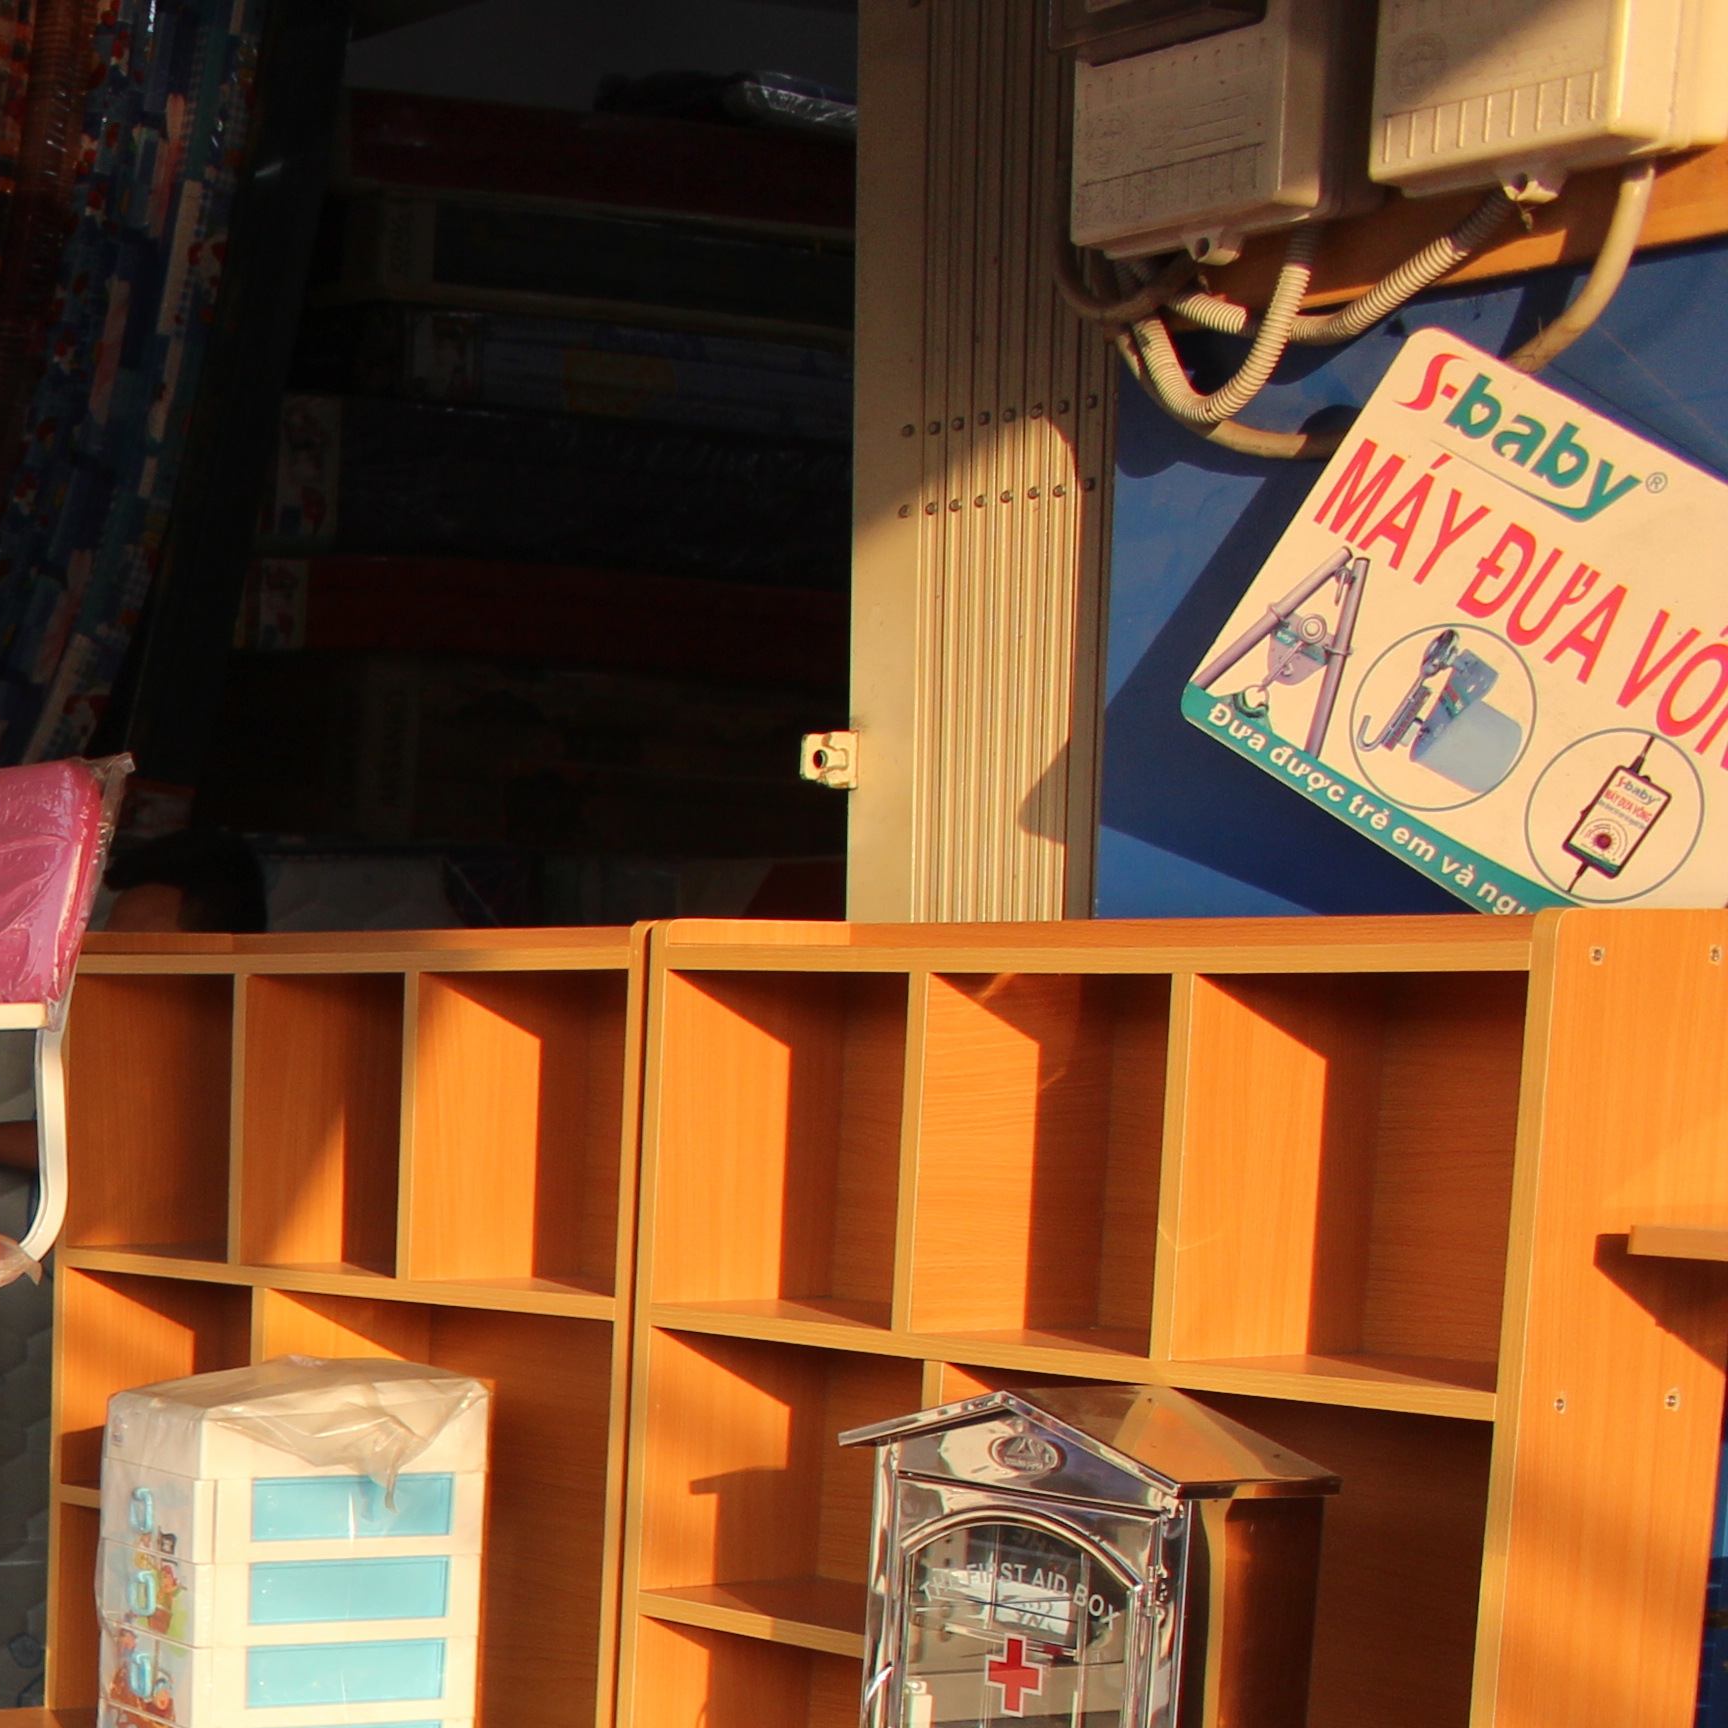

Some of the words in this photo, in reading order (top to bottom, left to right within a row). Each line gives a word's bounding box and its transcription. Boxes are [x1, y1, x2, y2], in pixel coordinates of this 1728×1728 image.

[1392, 353, 1643, 524] S-baby
[1312, 437, 1491, 586] MÁY
[1456, 522, 1628, 685] ĐƯA
[1207, 703, 1267, 751] Đưa
[1270, 743, 1348, 804] được
[1348, 793, 1391, 831] trẻ
[1392, 827, 1438, 864] em
[1441, 855, 1476, 888] và
[966, 1562, 1027, 1586] FIRST
[1032, 1567, 1068, 1594] AID
[1073, 1583, 1121, 1631] BOX
